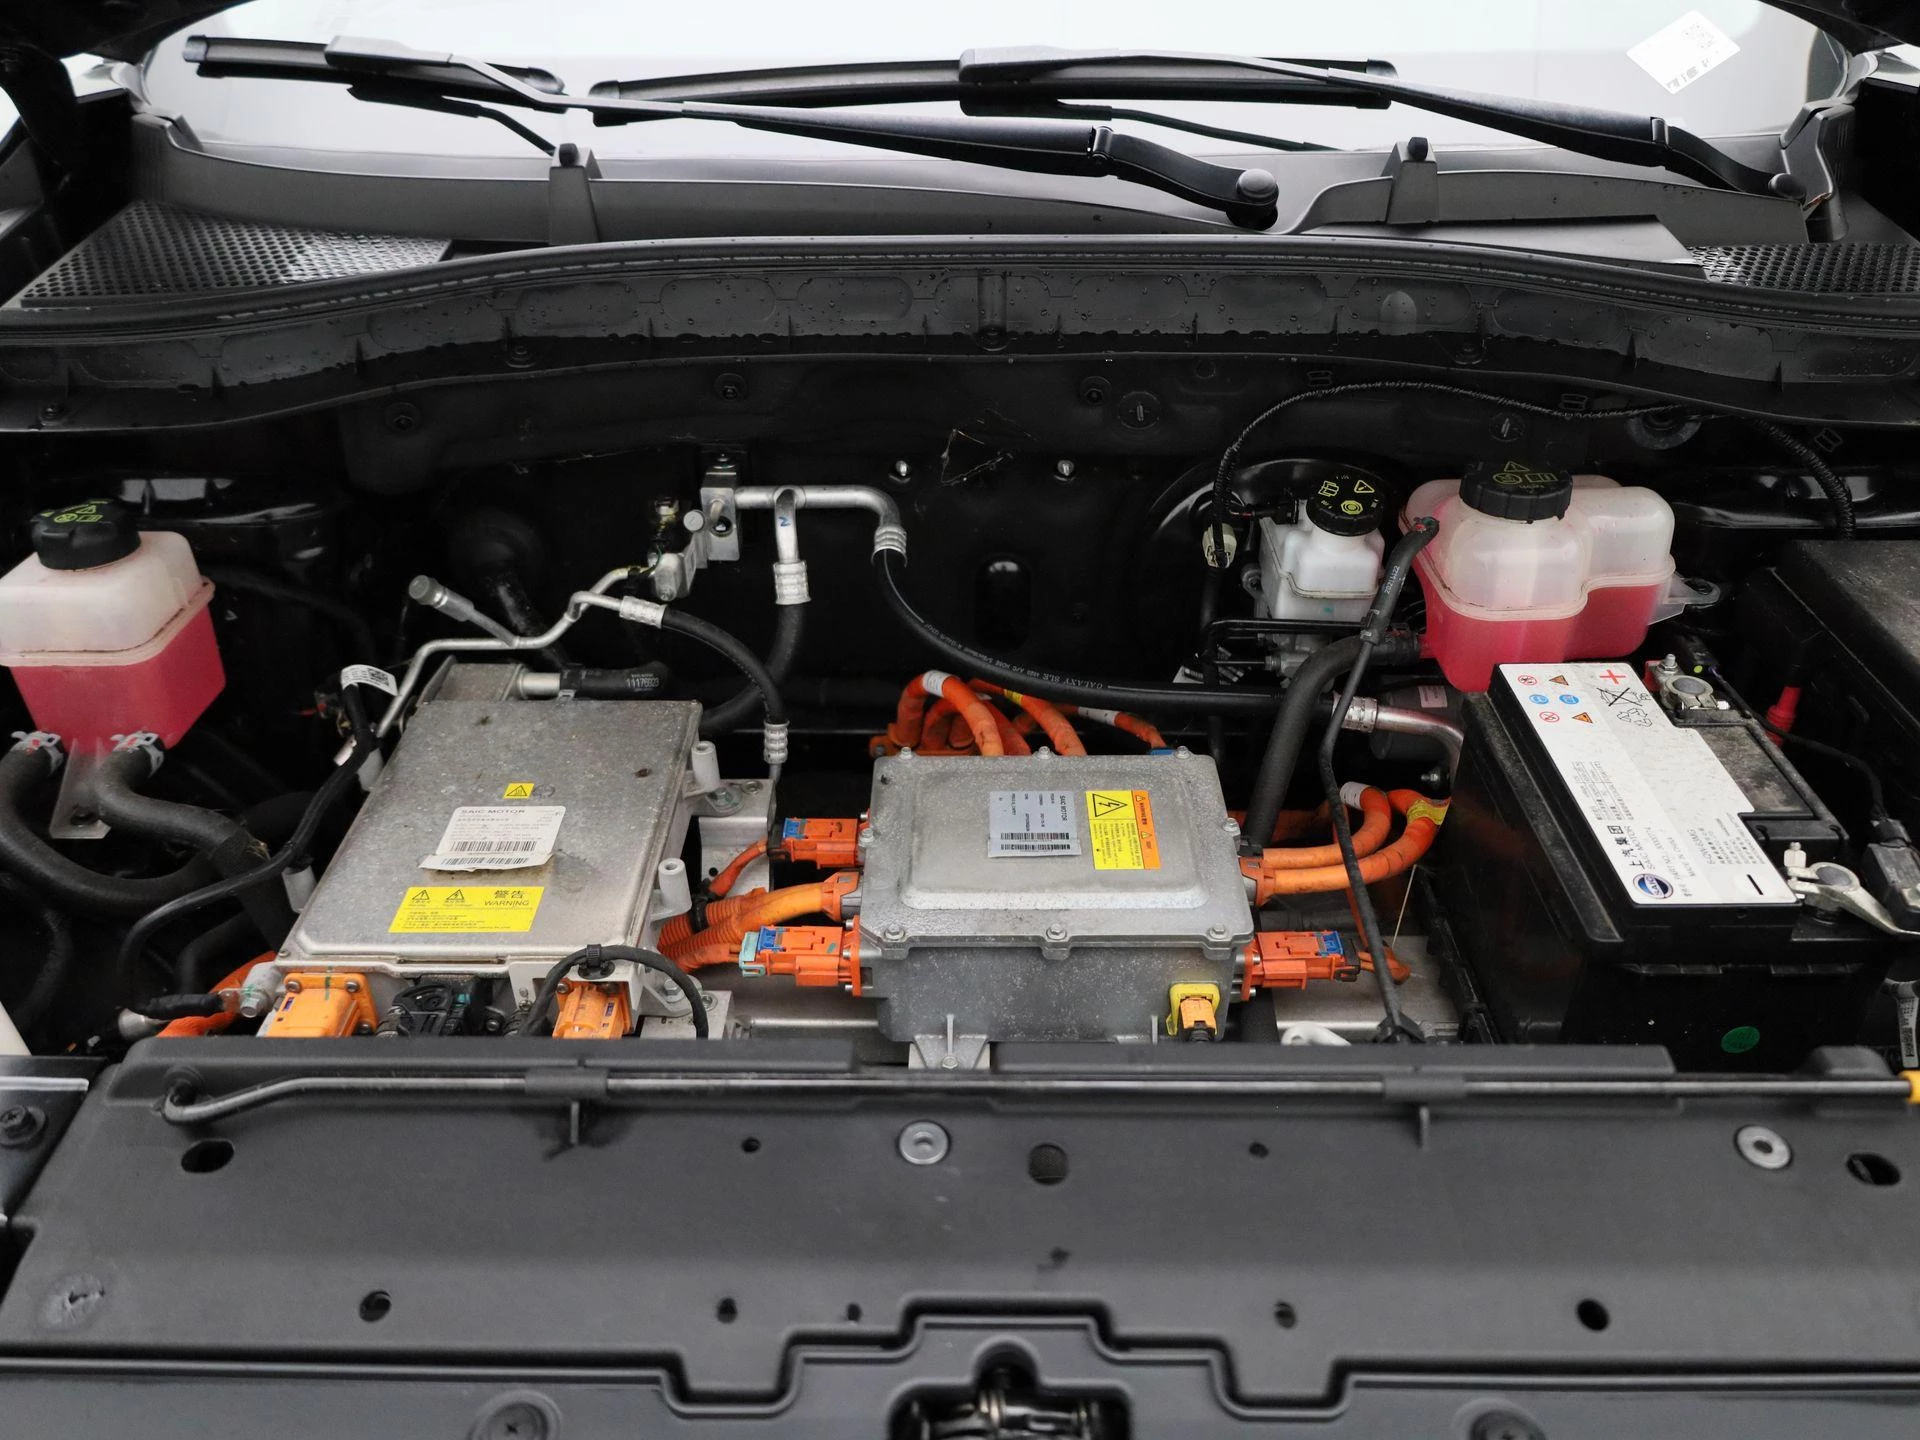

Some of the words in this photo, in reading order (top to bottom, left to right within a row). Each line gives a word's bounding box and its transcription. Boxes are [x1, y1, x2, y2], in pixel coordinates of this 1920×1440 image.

[1605, 824, 1646, 870] 上汽集团
[1644, 875, 1663, 896] SAIC
[493, 889, 524, 899] 警告
[484, 899, 530, 907] WARNING
